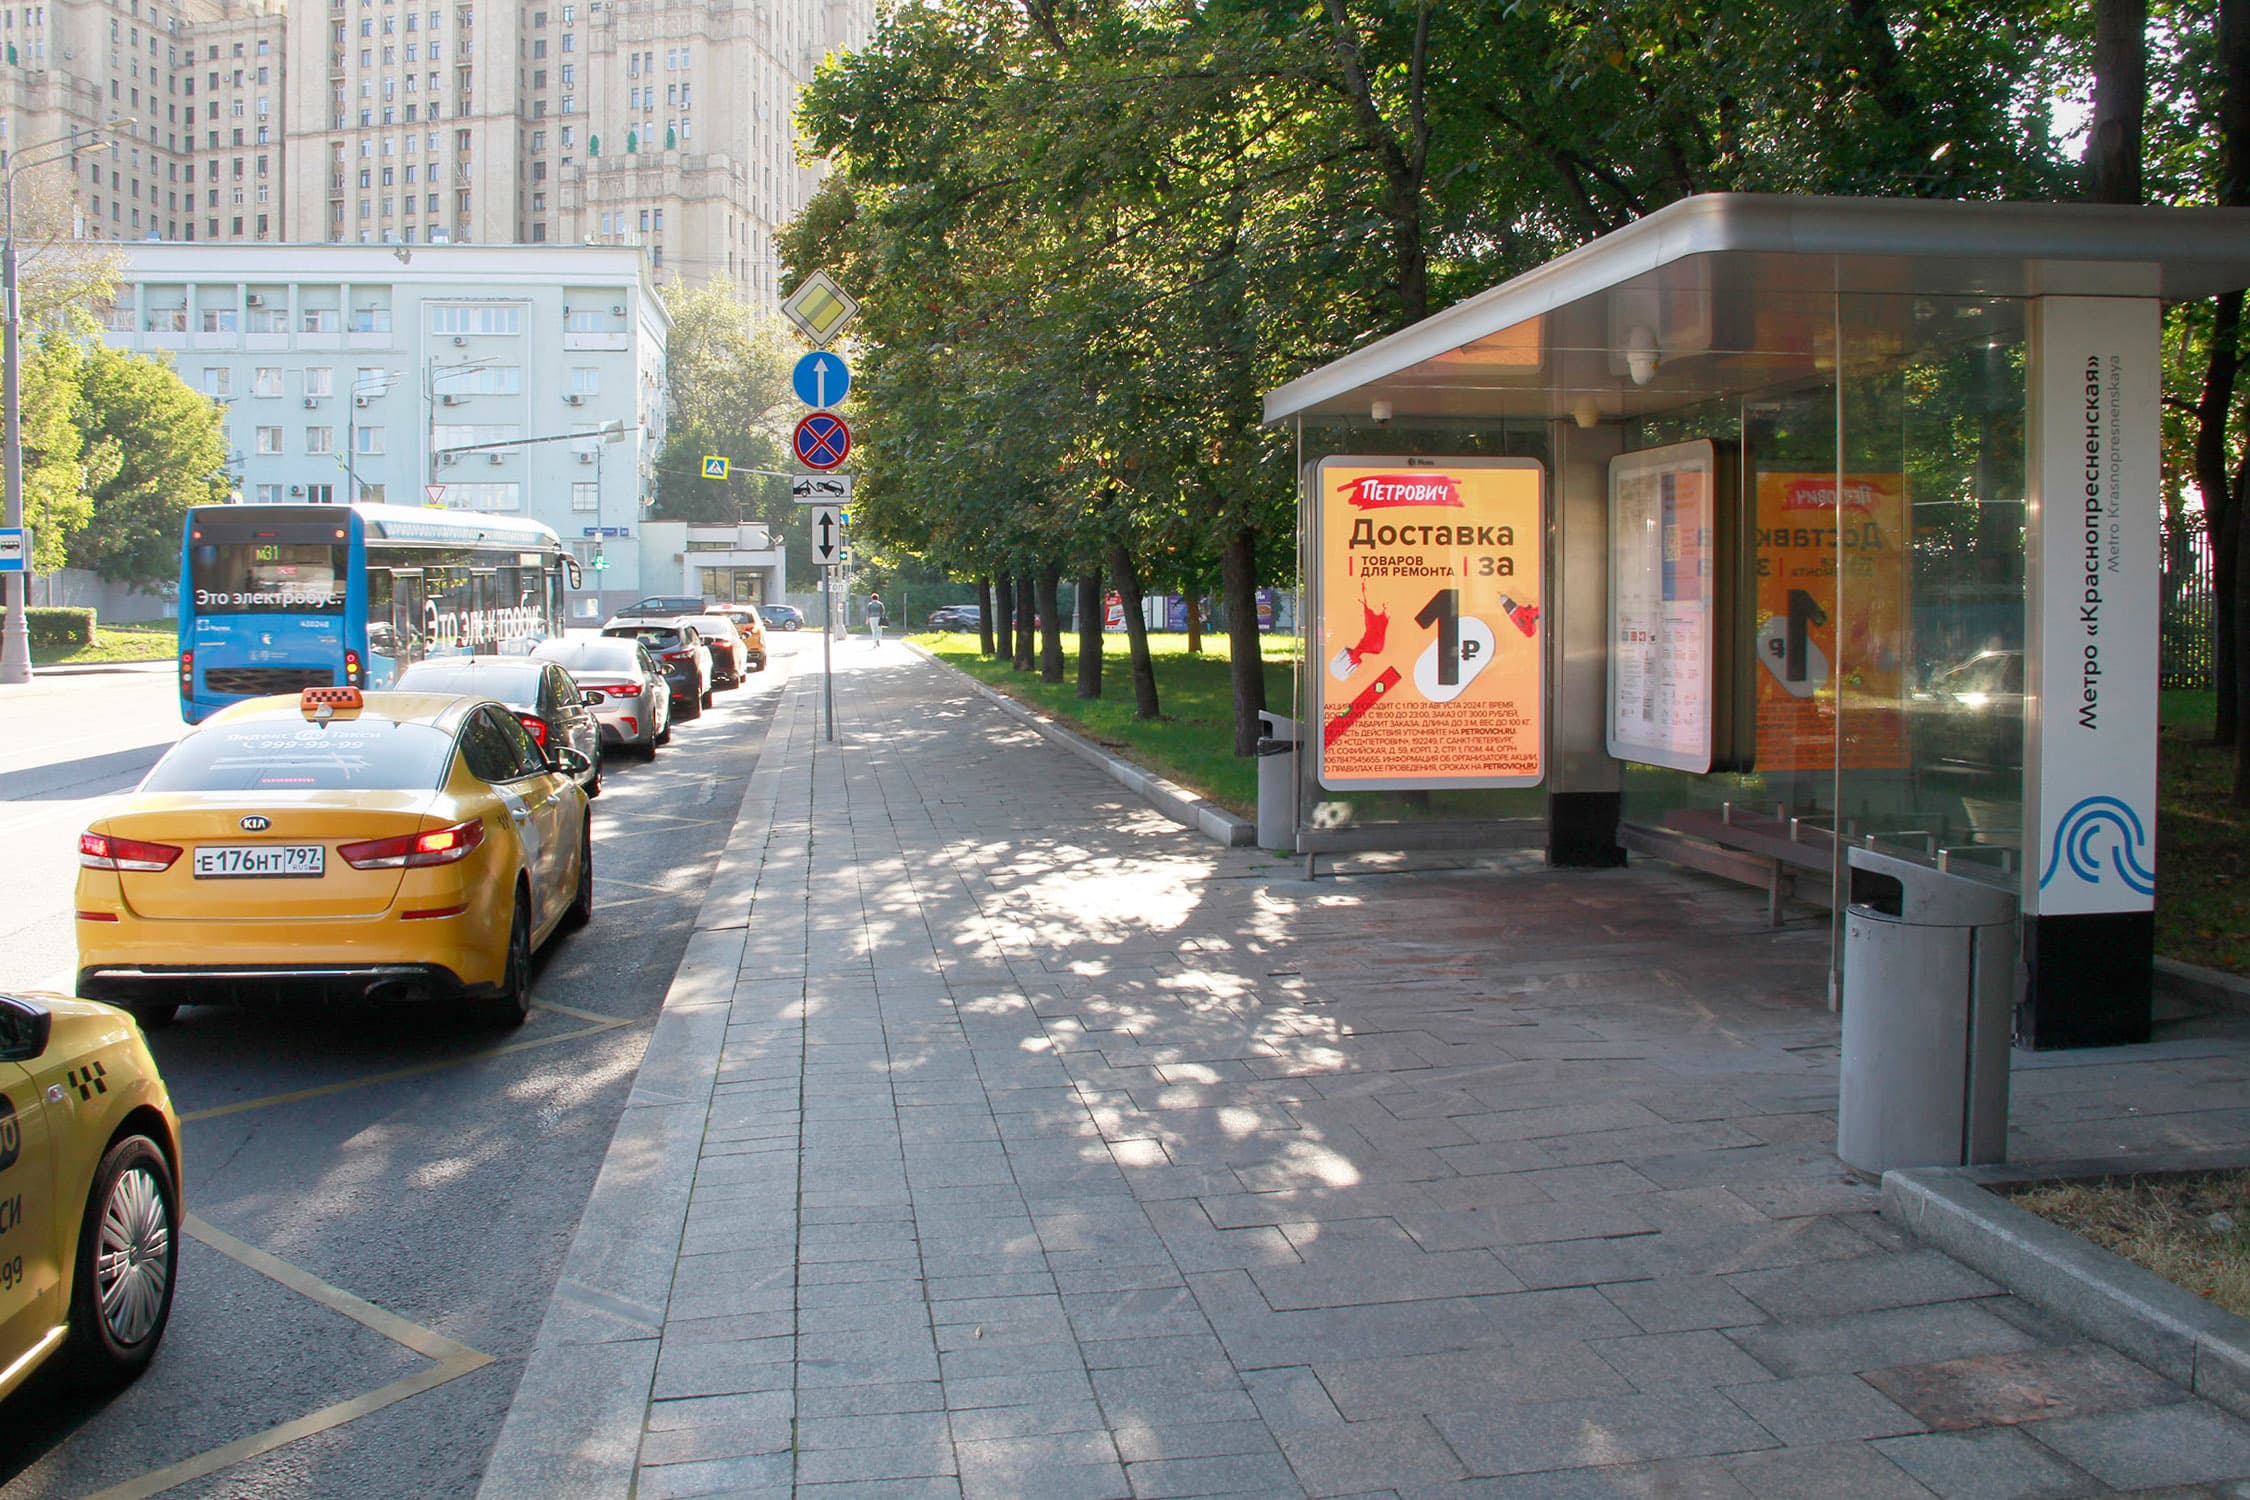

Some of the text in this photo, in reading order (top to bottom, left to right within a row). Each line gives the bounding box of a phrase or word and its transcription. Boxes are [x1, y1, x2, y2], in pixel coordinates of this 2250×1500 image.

[2107, 355, 2123, 573] Metro Krasnopresnenskaya
[1349, 518, 1514, 550] Доставка
[2078, 355, 2103, 730] Метро «Краснопресненская»
[1360, 566, 1456, 578] ДЛЯ РЕМОНТА
[1361, 556, 1424, 566] ТОВАРОВ
[1478, 556, 1514, 576] за
[195, 589, 229, 605] Это
[425, 599, 458, 652] Это
[1414, 589, 1459, 685] 1
[1396, 711, 1408, 719] ДО
[243, 818, 267, 829] KIA
[201, 848, 318, 872] Е176НТ 797
